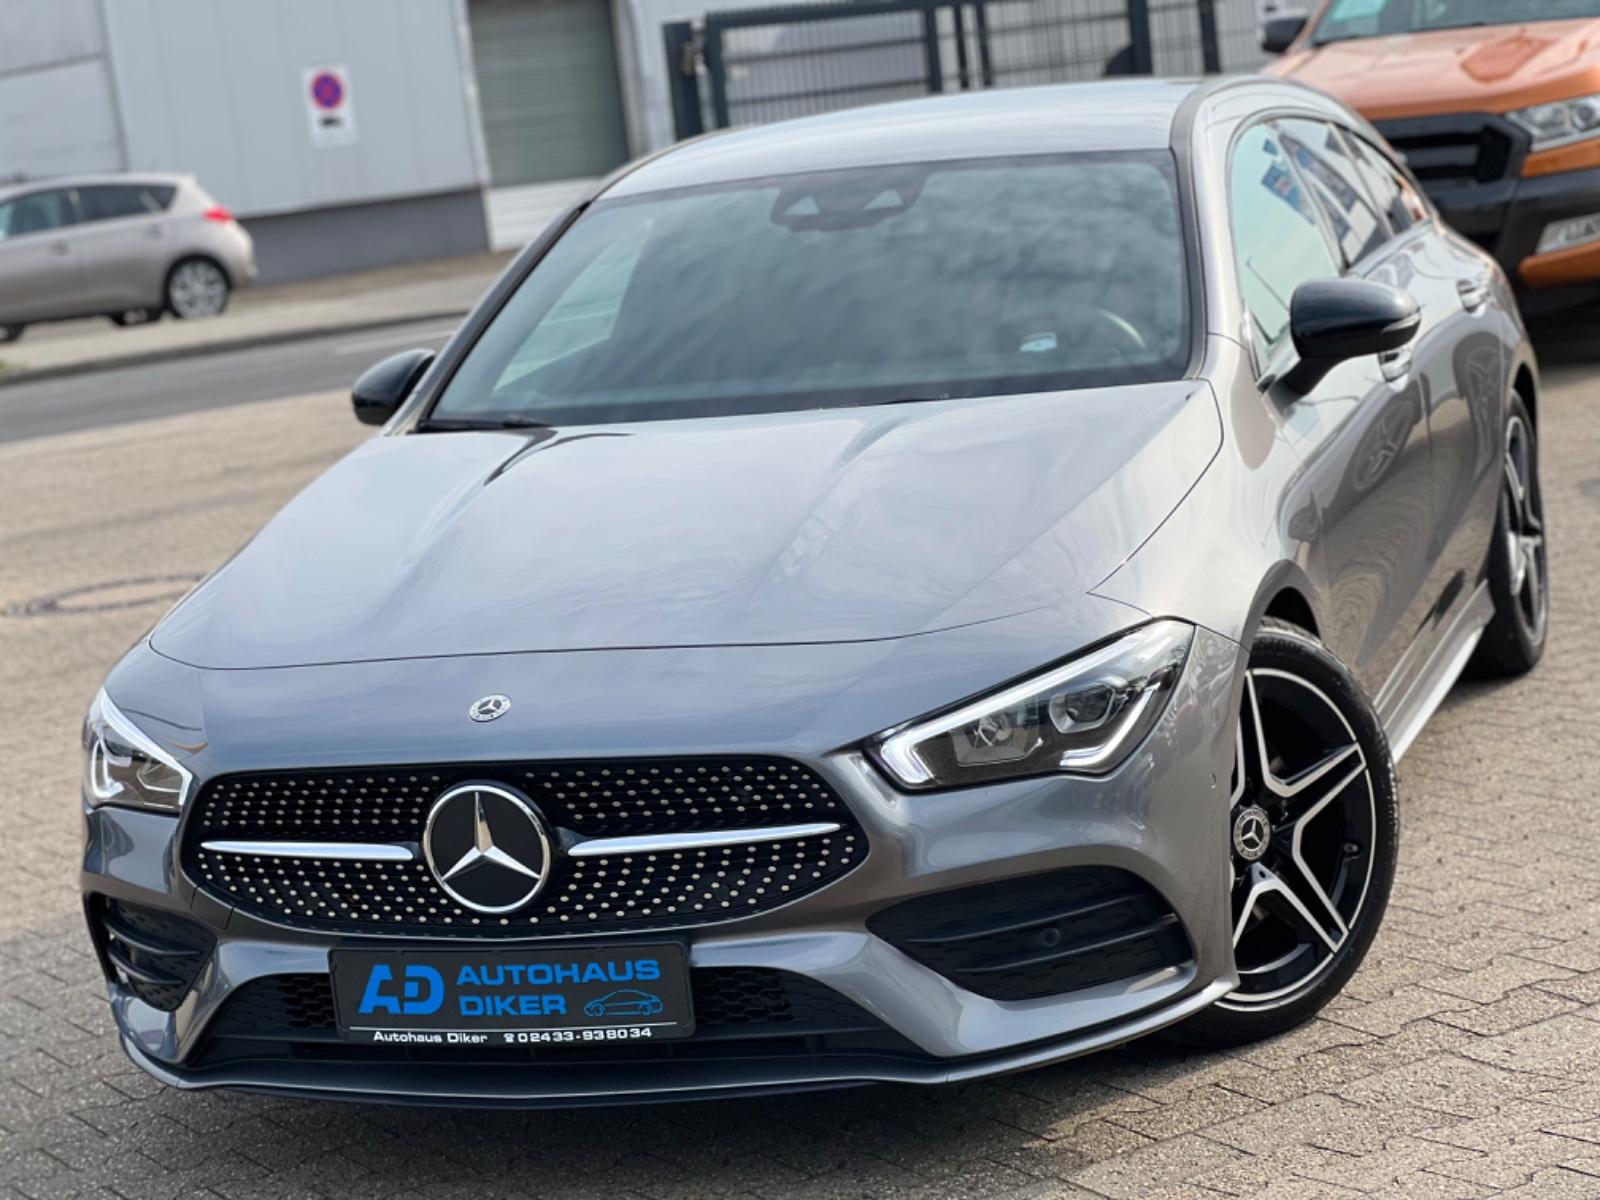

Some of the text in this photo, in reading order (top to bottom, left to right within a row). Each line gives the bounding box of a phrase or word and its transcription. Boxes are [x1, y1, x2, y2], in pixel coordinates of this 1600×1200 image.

[456, 959, 661, 986] AUTOHAUS
[459, 994, 567, 1017] DIKER
[373, 1031, 442, 1043] Autohaus
[446, 1032, 488, 1044] Diker
